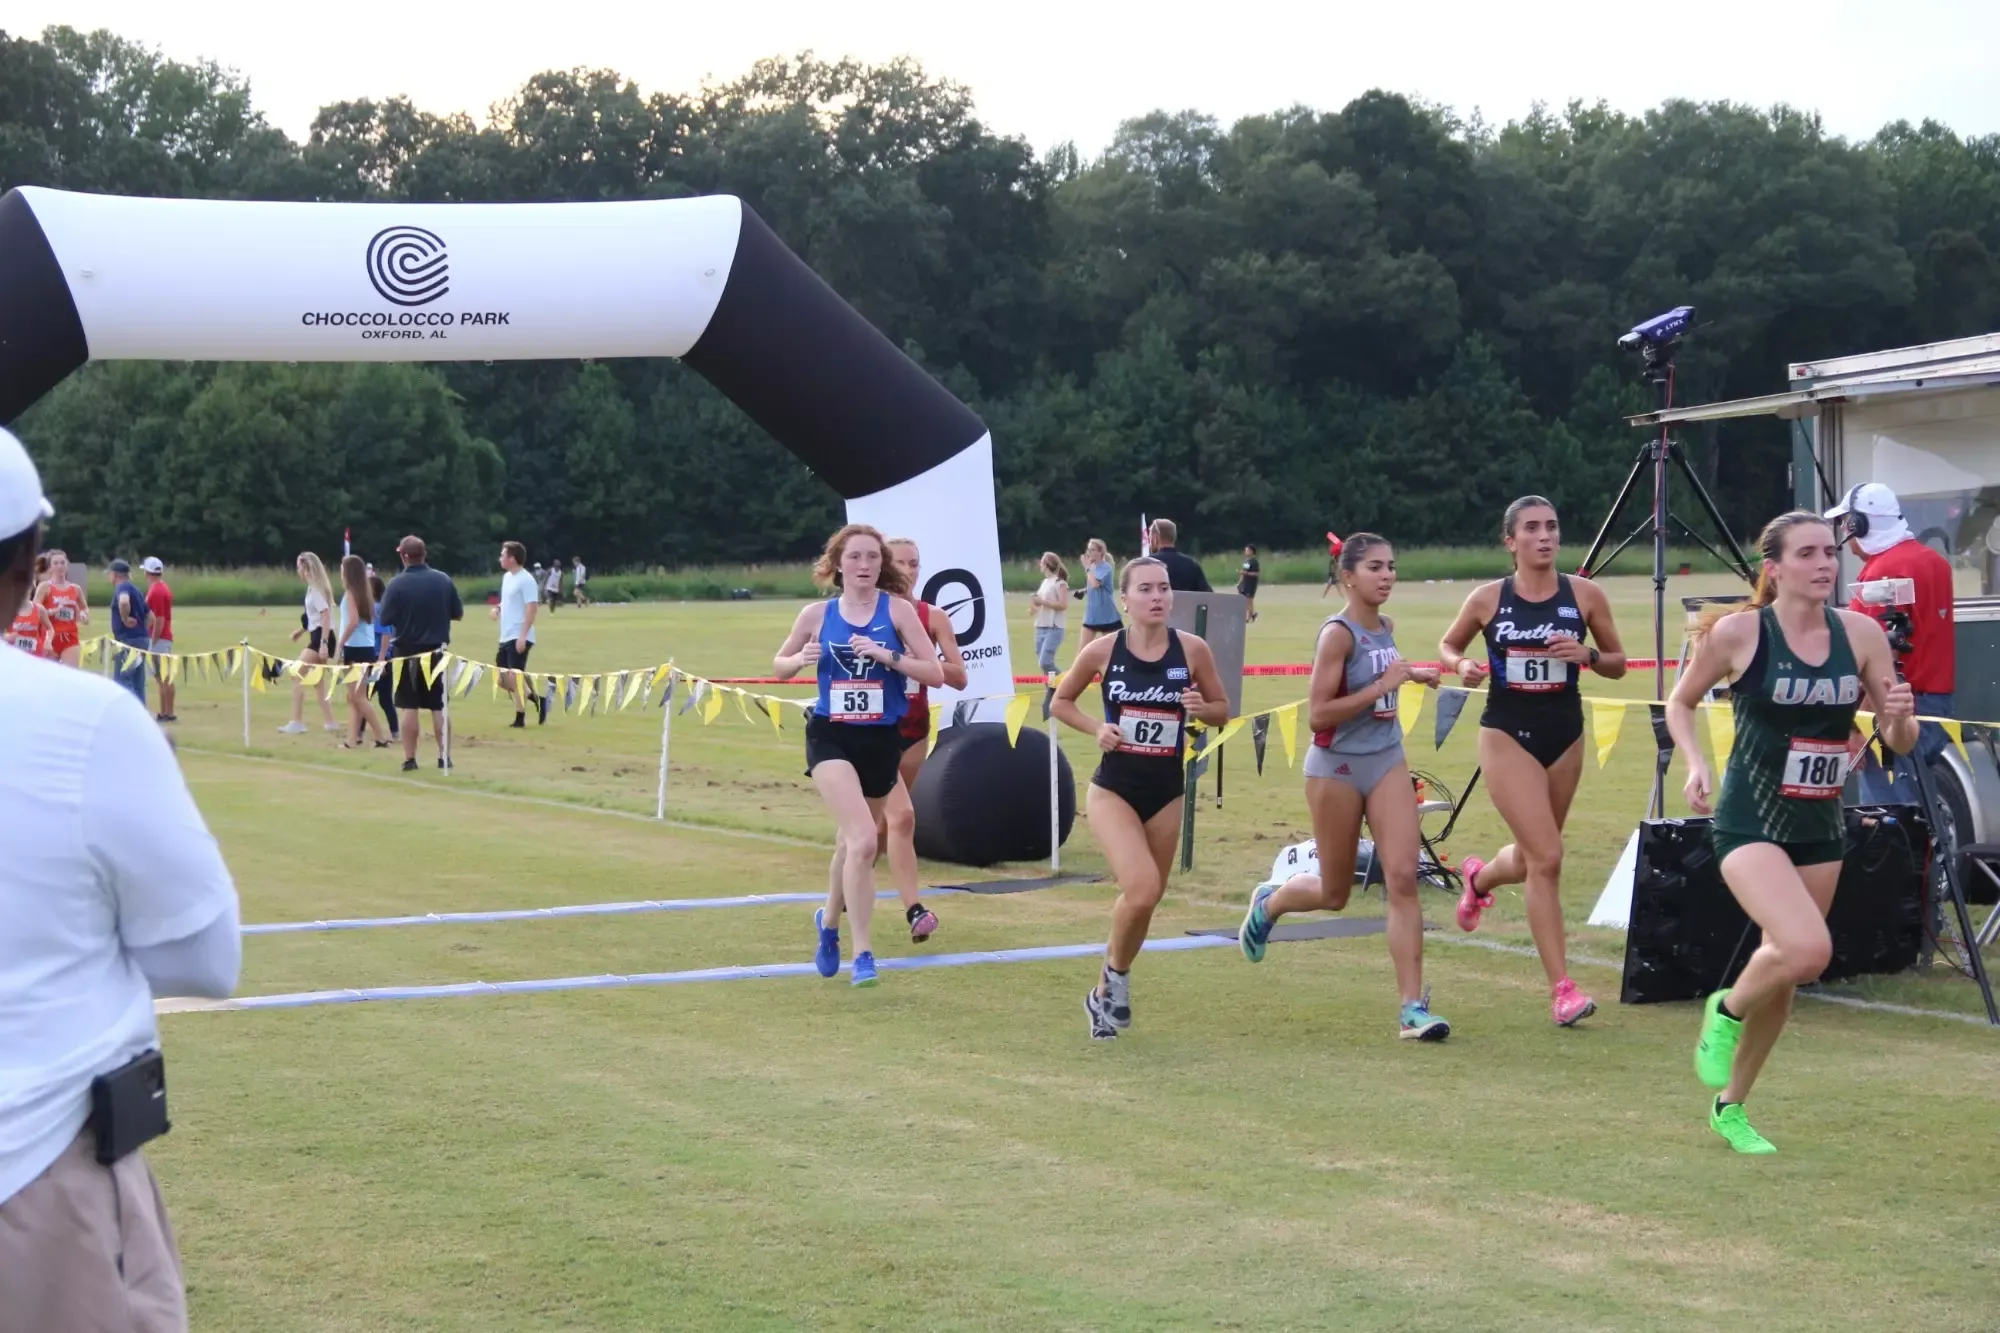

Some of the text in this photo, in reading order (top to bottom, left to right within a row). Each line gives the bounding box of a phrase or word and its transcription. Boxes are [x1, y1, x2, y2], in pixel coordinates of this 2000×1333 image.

[301, 312, 510, 326] CHOCCOLOCCO PARK
[1665, 318, 1684, 331] LYNX
[361, 330, 447, 340] OXFORD, AL
[961, 645, 1003, 661] OXFORD
[1167, 667, 1188, 680] SBC
[1525, 659, 1549, 681] 61
[1772, 674, 1861, 705] UAB
[844, 691, 869, 712] 53
[1134, 720, 1164, 745] 62
[1799, 755, 1840, 785] 180
